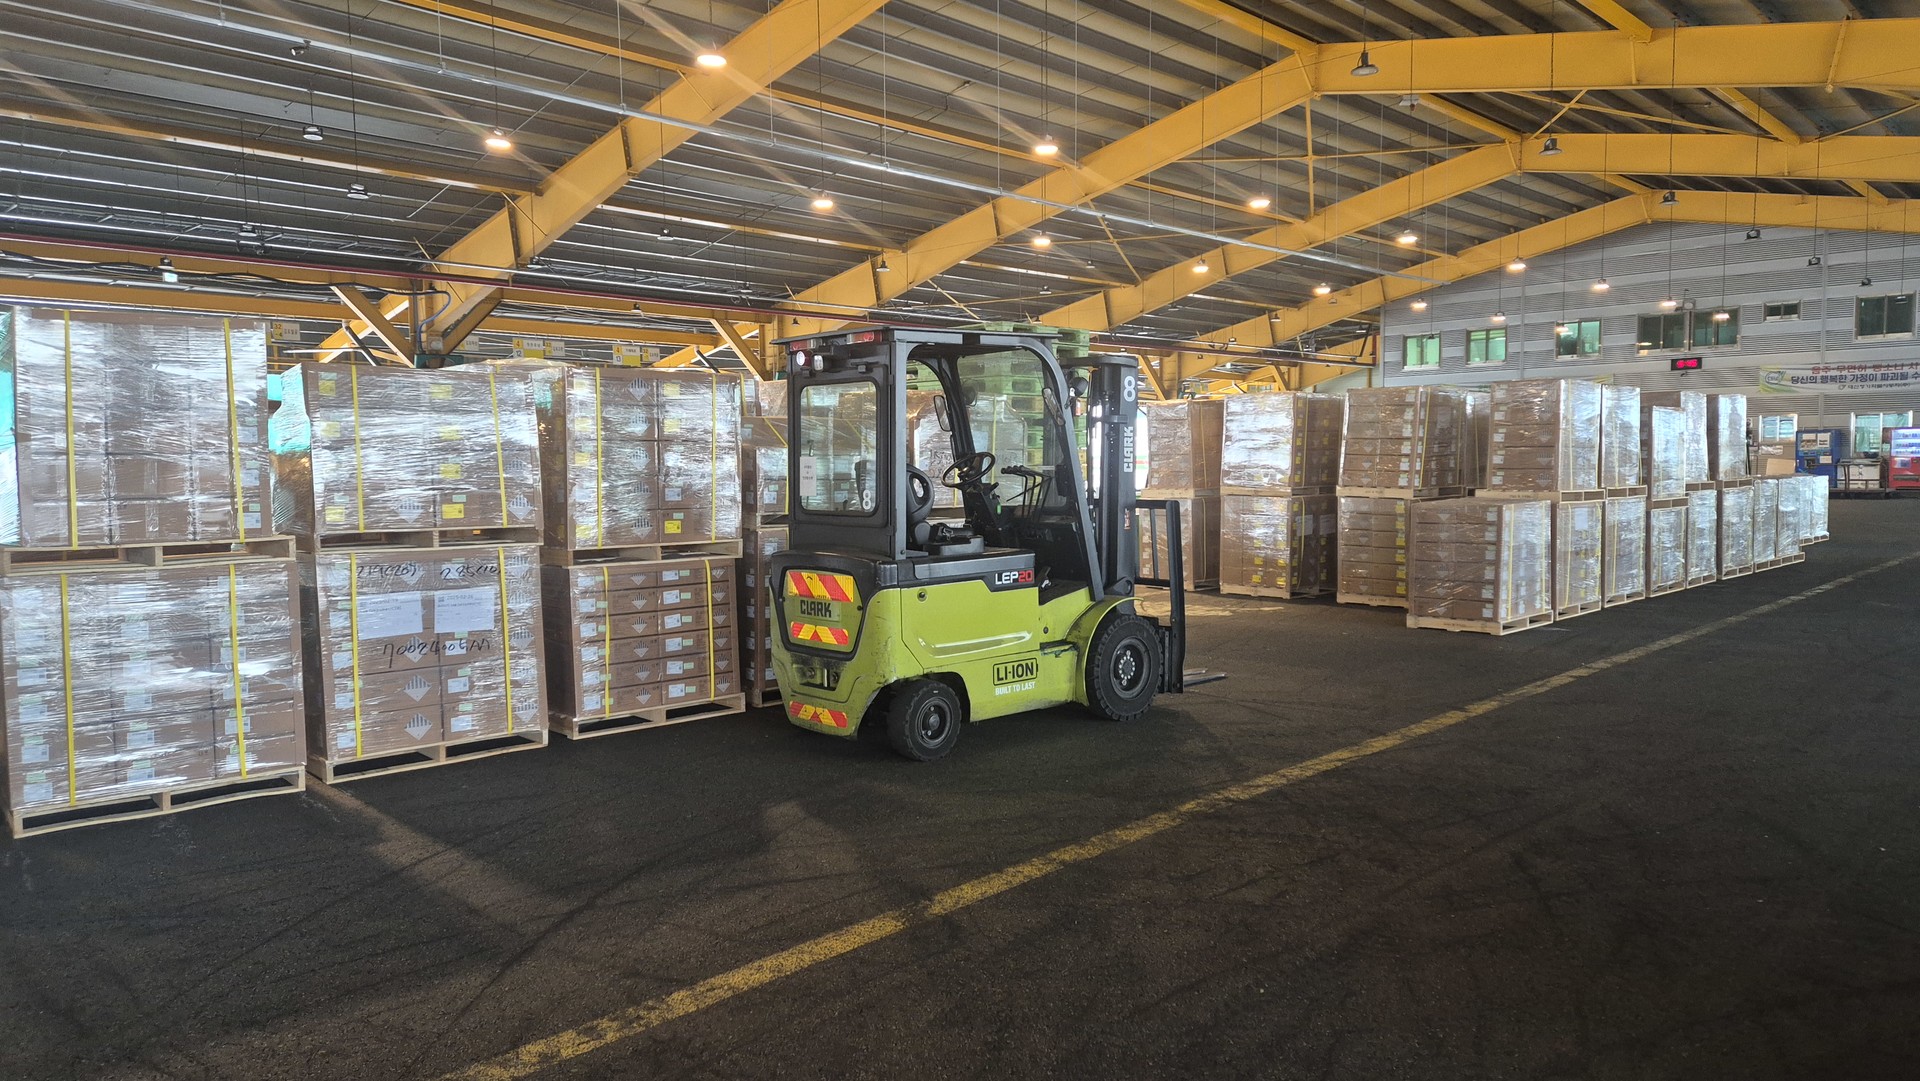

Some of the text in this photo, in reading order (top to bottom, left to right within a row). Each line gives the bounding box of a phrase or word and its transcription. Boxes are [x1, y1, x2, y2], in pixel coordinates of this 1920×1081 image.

[1791, 371, 1920, 384] 당신의 행복한 가정이 파괴될 수
[1123, 375, 1136, 402] 8
[1123, 426, 1134, 473] CLARK
[862, 489, 871, 510] 8
[995, 570, 1033, 585] LEP20
[800, 599, 832, 618] CLARK
[995, 681, 1035, 696] BUILT TO LAST
